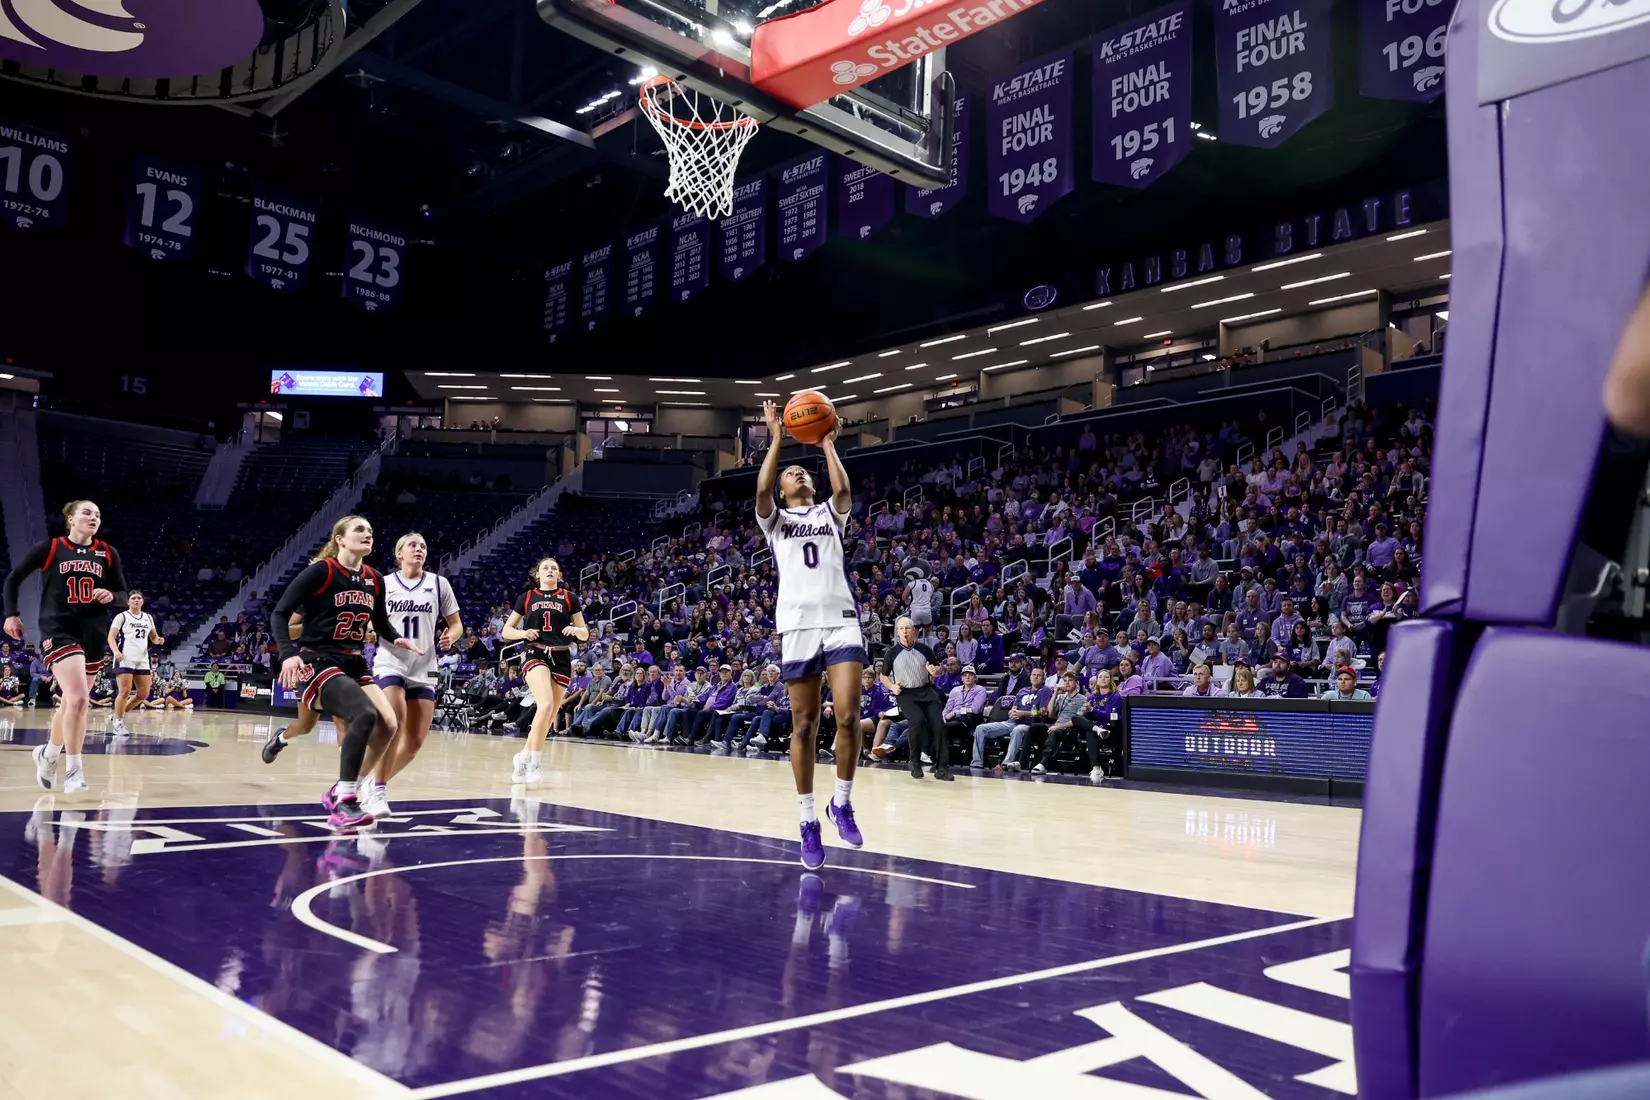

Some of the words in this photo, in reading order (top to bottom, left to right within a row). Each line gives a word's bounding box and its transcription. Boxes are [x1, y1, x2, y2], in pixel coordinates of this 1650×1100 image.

[867, 0, 1035, 67] StateFar
[1099, 11, 1183, 60] K-STATE
[1236, 9, 1308, 52] FINAL
[1105, 49, 1128, 65] MEN'S
[1129, 31, 1177, 55] BASKETBALL
[1236, 31, 1306, 73] FOUR
[1382, 24, 1447, 72] 196
[992, 58, 1066, 100] K-STATE
[1111, 60, 1172, 98] FINAL
[997, 93, 1018, 106] MEN'S
[1018, 77, 1060, 98] BASKETBALL
[1111, 80, 1170, 118] FOUR
[1232, 71, 1313, 120] 1958
[1002, 103, 1055, 137] FINAL
[0, 126, 68, 154] WILLIAMS
[1002, 122, 1053, 156] FOUR
[1110, 116, 1175, 161] 1951
[0, 145, 64, 202] 10
[146, 166, 188, 186] EVANS
[782, 155, 824, 181] K-STATE
[843, 170, 865, 184] SWEET
[998, 157, 1058, 196] 1948
[733, 179, 762, 199] STATE
[778, 193, 799, 208] SWEET
[799, 183, 824, 200] SIXTEEN
[848, 191, 864, 204] 2023
[849, 182, 865, 194] 2018
[3, 199, 50, 218] 1972-76
[135, 182, 193, 237] 12
[253, 197, 316, 223] BLACKMAN
[672, 211, 706, 229] K-STAE
[720, 214, 739, 228] SWEET
[739, 206, 763, 221] SIXTEEN
[784, 207, 798, 217] 1972
[803, 200, 817, 210] 1981
[784, 216, 798, 226] 1973
[803, 209, 817, 219] 1982
[138, 232, 181, 251] 1974-78
[252, 214, 310, 265] 25
[350, 223, 406, 247] RICHMOND
[626, 226, 659, 248] K-STATE
[678, 231, 697, 245] NCAA
[783, 225, 797, 235] 1975
[783, 234, 797, 244] 1977
[801, 227, 816, 238] 2010
[741, 248, 755, 258] 1970
[1095, 234, 1242, 295] KANSAS
[1274, 191, 1413, 254] STATE
[349, 239, 400, 288] 23
[632, 250, 650, 264] NCAA
[260, 263, 299, 280] 1977-81
[355, 286, 391, 302] 1986-88
[120, 374, 149, 396] 15
[781, 522, 834, 539] Wildcats
[802, 541, 820, 569] 0
[59, 559, 102, 578] UTAH
[66, 576, 95, 604] 10
[922, 583, 927, 592] 0
[334, 589, 374, 610] UTAH
[388, 600, 432, 613] Wildcats
[531, 600, 563, 612] UTAH
[333, 611, 370, 640] 23
[402, 615, 419, 639] 11
[542, 611, 553, 632] 1
[135, 629, 146, 639] 23
[1184, 735, 1276, 757] OUTDOOR
